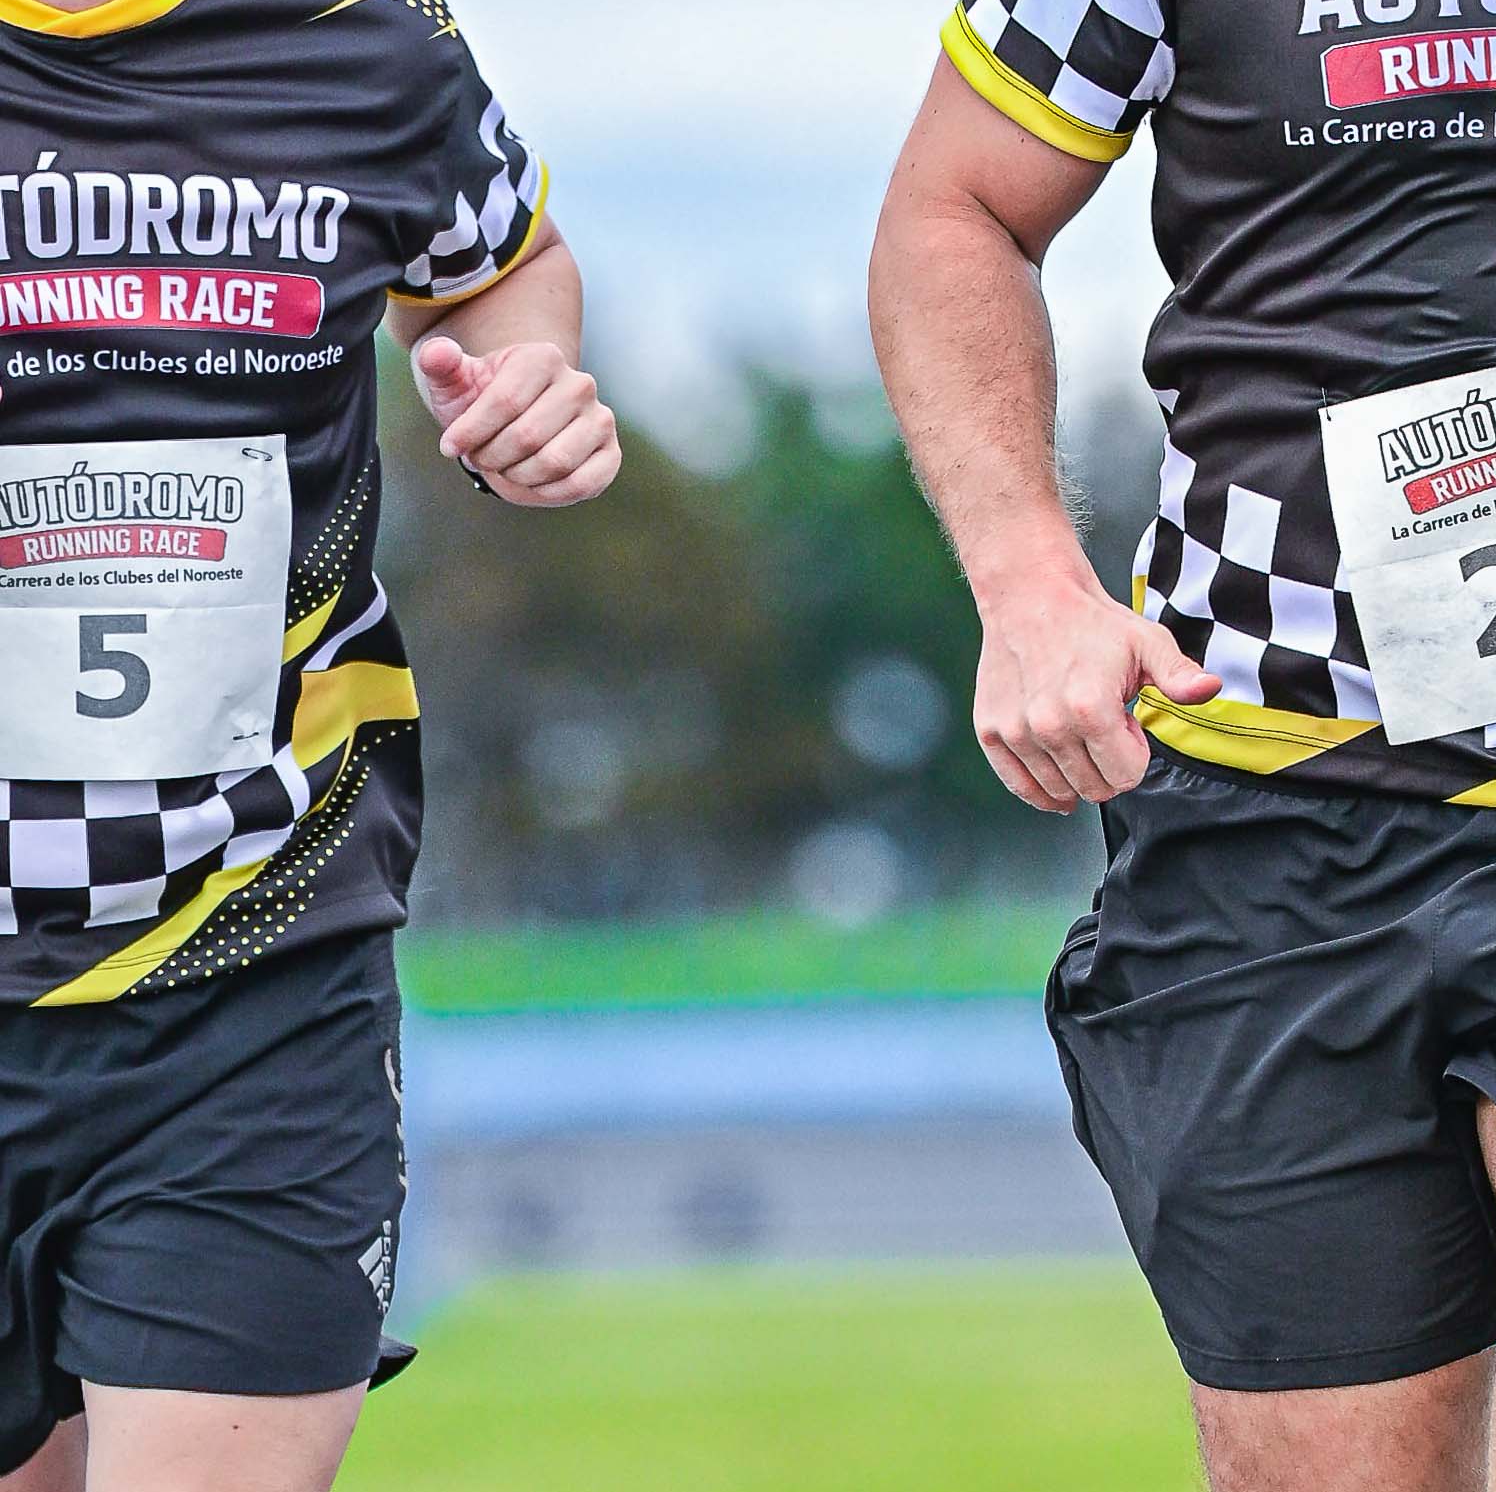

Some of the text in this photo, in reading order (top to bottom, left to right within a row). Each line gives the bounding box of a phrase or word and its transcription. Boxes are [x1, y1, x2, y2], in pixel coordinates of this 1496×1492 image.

[1283, 120, 1315, 147] La
[1323, 116, 1436, 147] Carrera
[1445, 112, 1485, 139] de
[0, 274, 278, 330] NNING RACE
[6, 344, 344, 378] de los Clubes del Noroeste
[1391, 525, 1410, 540] La
[1412, 512, 1469, 536] Carrera
[1471, 503, 1491, 519] de
[23, 529, 203, 563] RUNNING RACE
[56, 572, 75, 586] de
[78, 571, 100, 586] los
[103, 570, 154, 585] Clubes
[157, 569, 179, 584] del
[183, 567, 244, 583] Noroeste
[75, 613, 151, 720] 5
